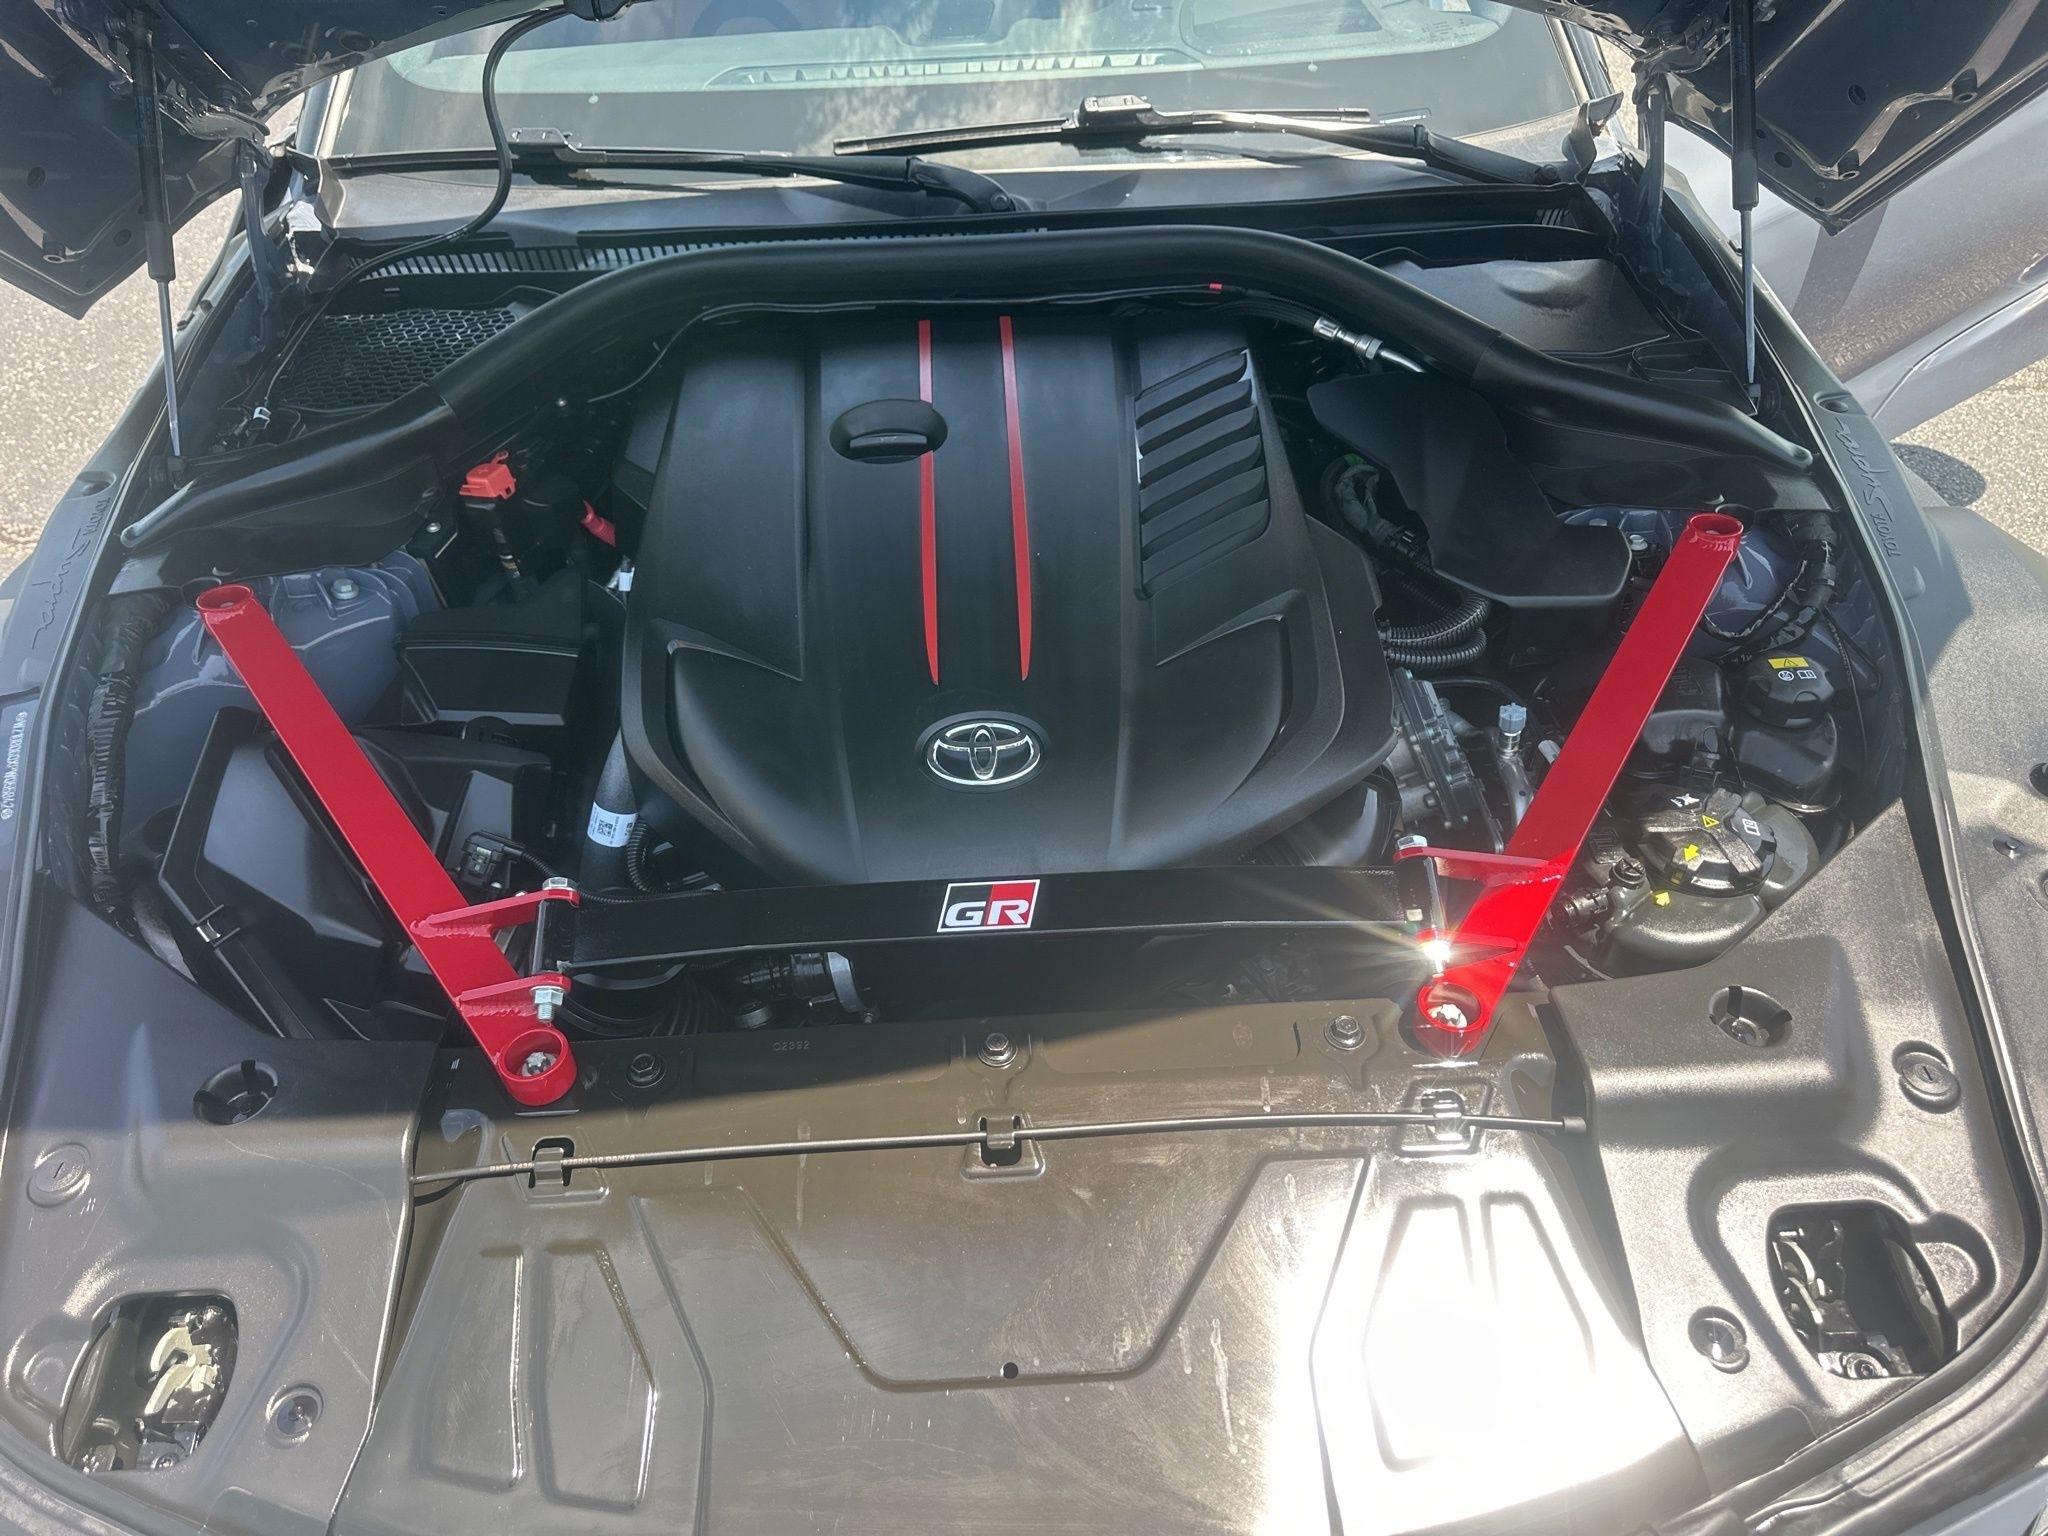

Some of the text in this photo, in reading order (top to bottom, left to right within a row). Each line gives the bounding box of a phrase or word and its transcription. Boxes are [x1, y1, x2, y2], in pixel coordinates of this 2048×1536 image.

[1834, 416, 1902, 558] TOYOTA Supra
[82, 496, 111, 537] TOYOTA
[945, 899, 1030, 926] GR
